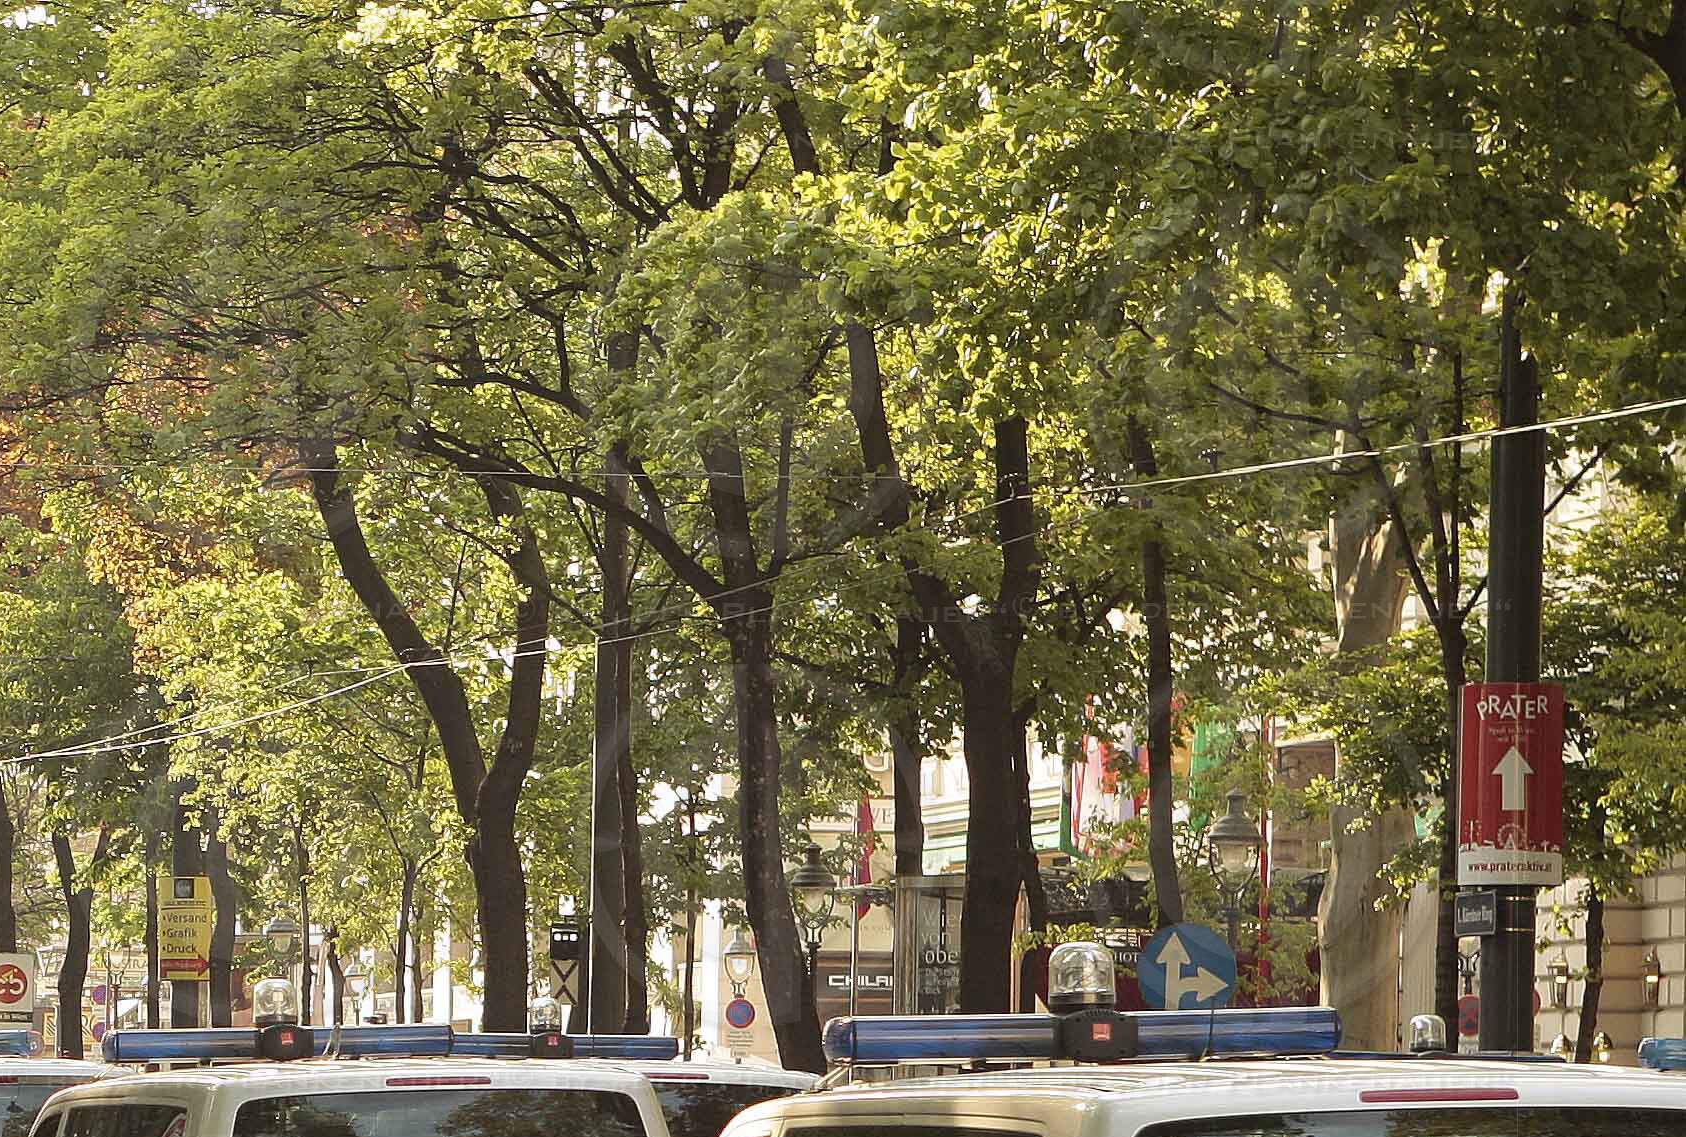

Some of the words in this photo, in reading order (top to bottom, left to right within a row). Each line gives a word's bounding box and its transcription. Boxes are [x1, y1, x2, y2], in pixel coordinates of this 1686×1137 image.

[1476, 694, 1549, 720] PRATER
[167, 912, 207, 923] Versand
[166, 928, 196, 938] Grafik
[166, 943, 196, 953] Druck
[925, 944, 960, 964] obe
